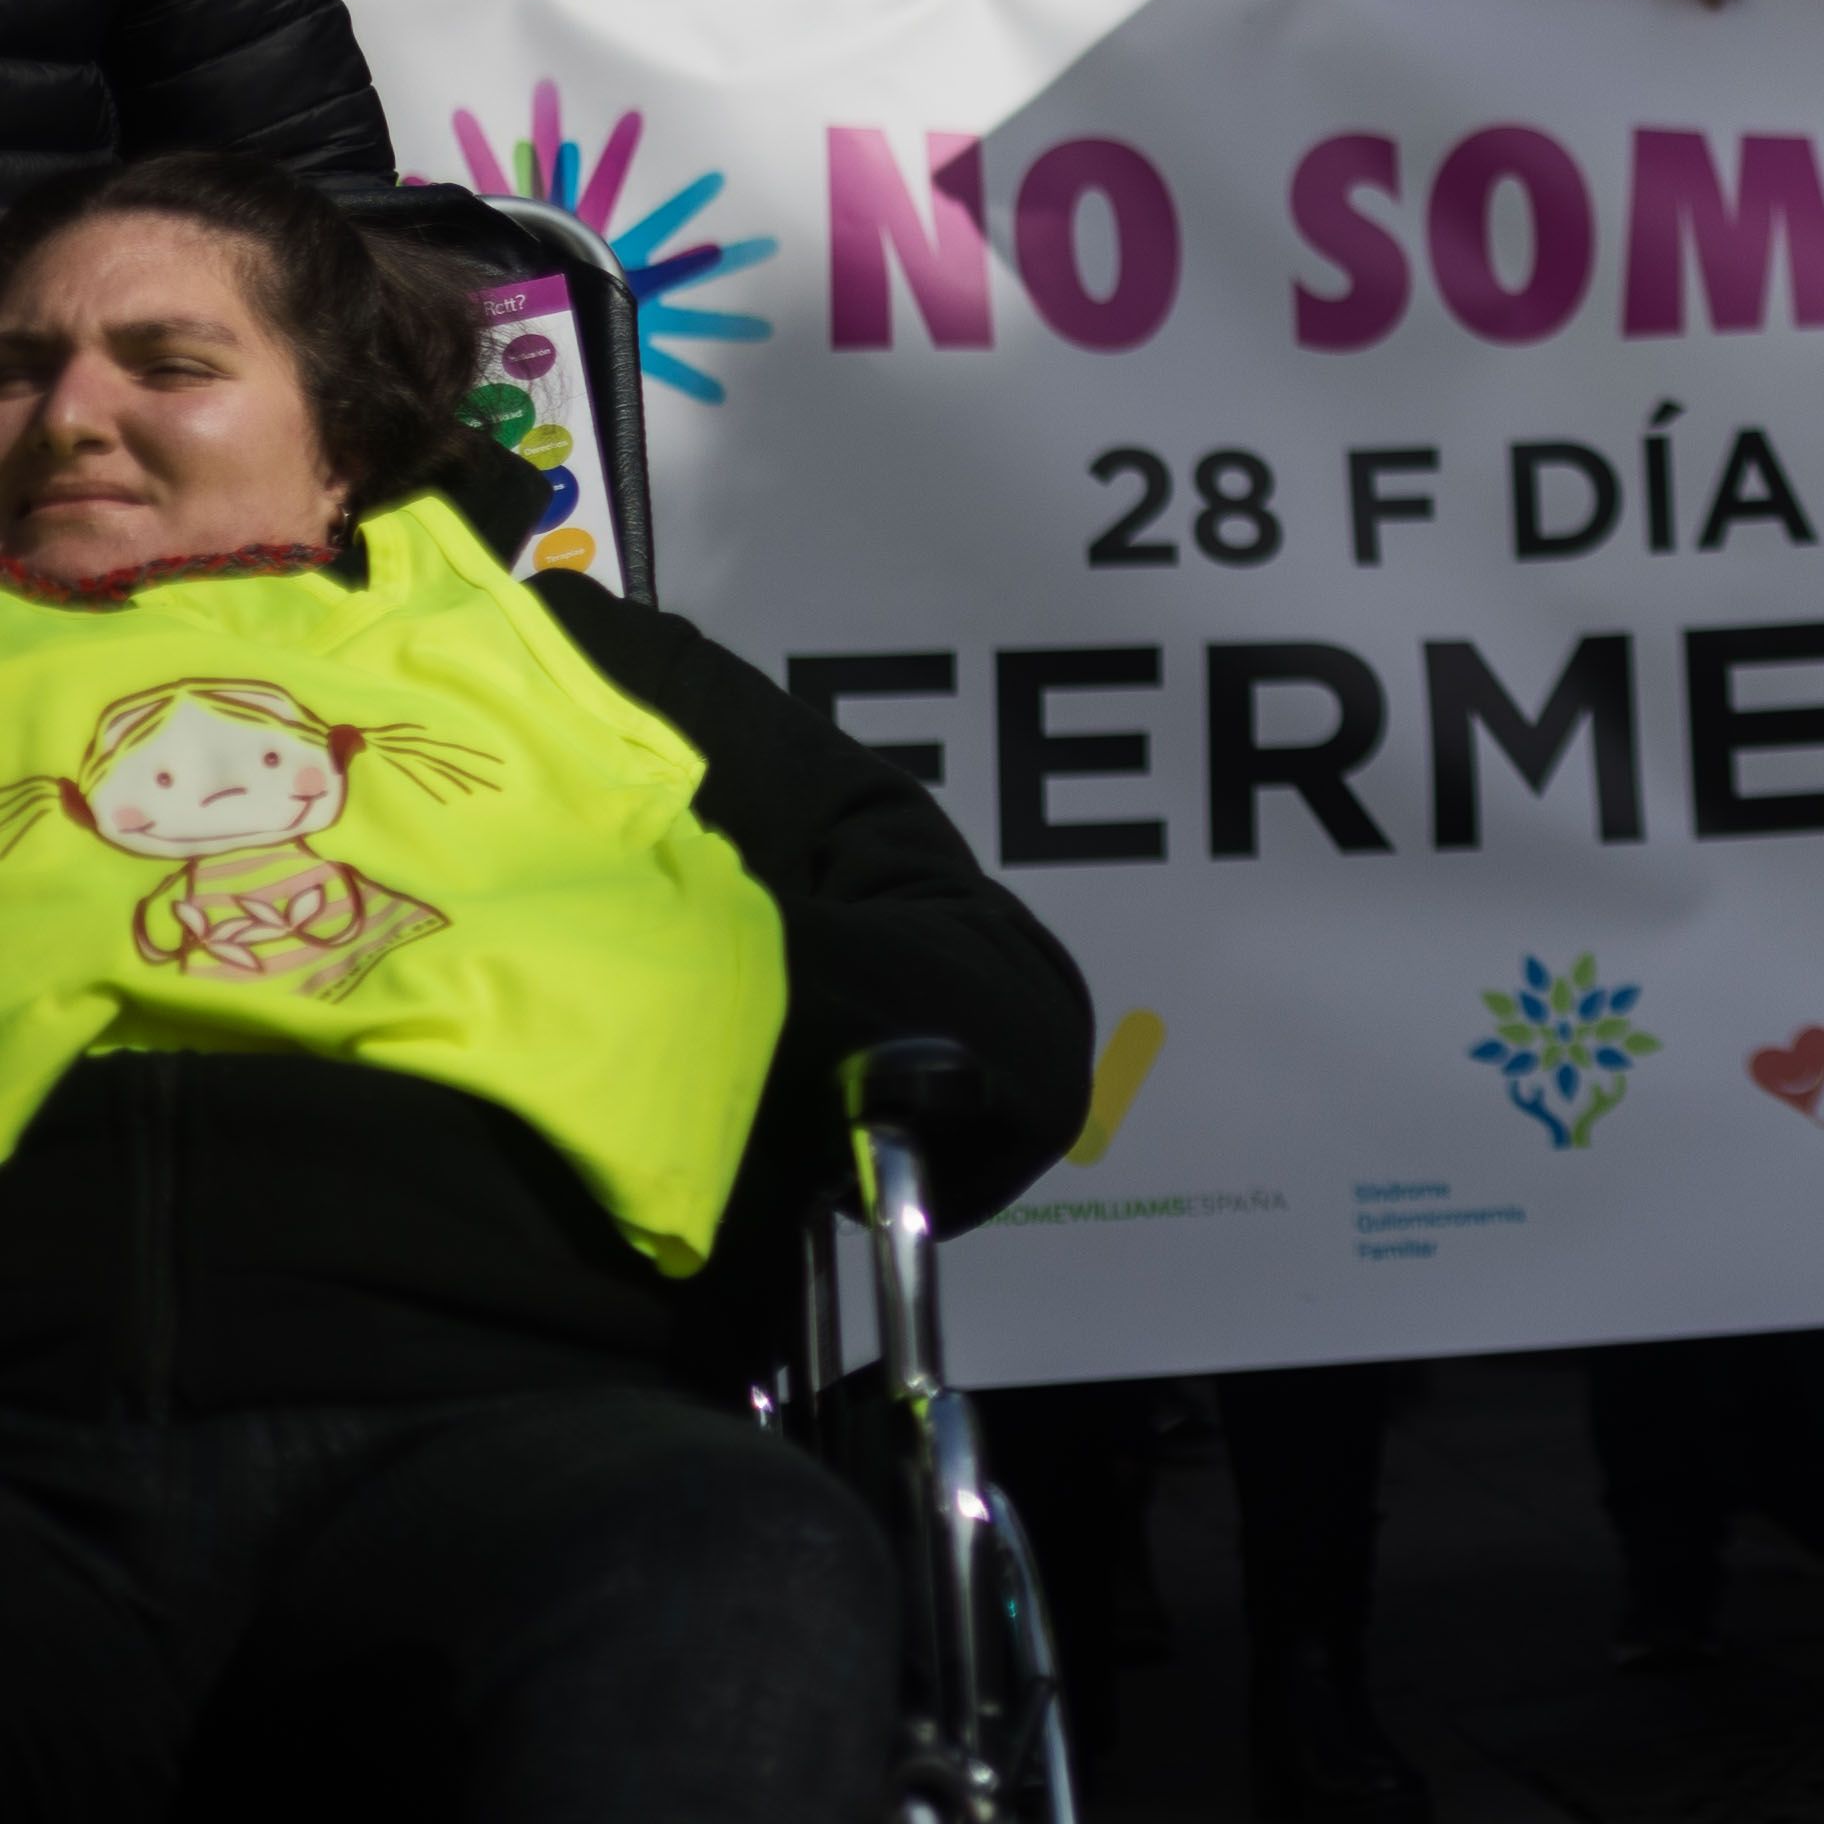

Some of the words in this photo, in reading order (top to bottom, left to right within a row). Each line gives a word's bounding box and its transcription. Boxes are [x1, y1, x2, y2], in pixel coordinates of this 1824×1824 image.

[825, 124, 1182, 354] NO
[1086, 444, 1282, 568] 28
[1347, 446, 1440, 568] F
[1510, 398, 1818, 564] DÍA
